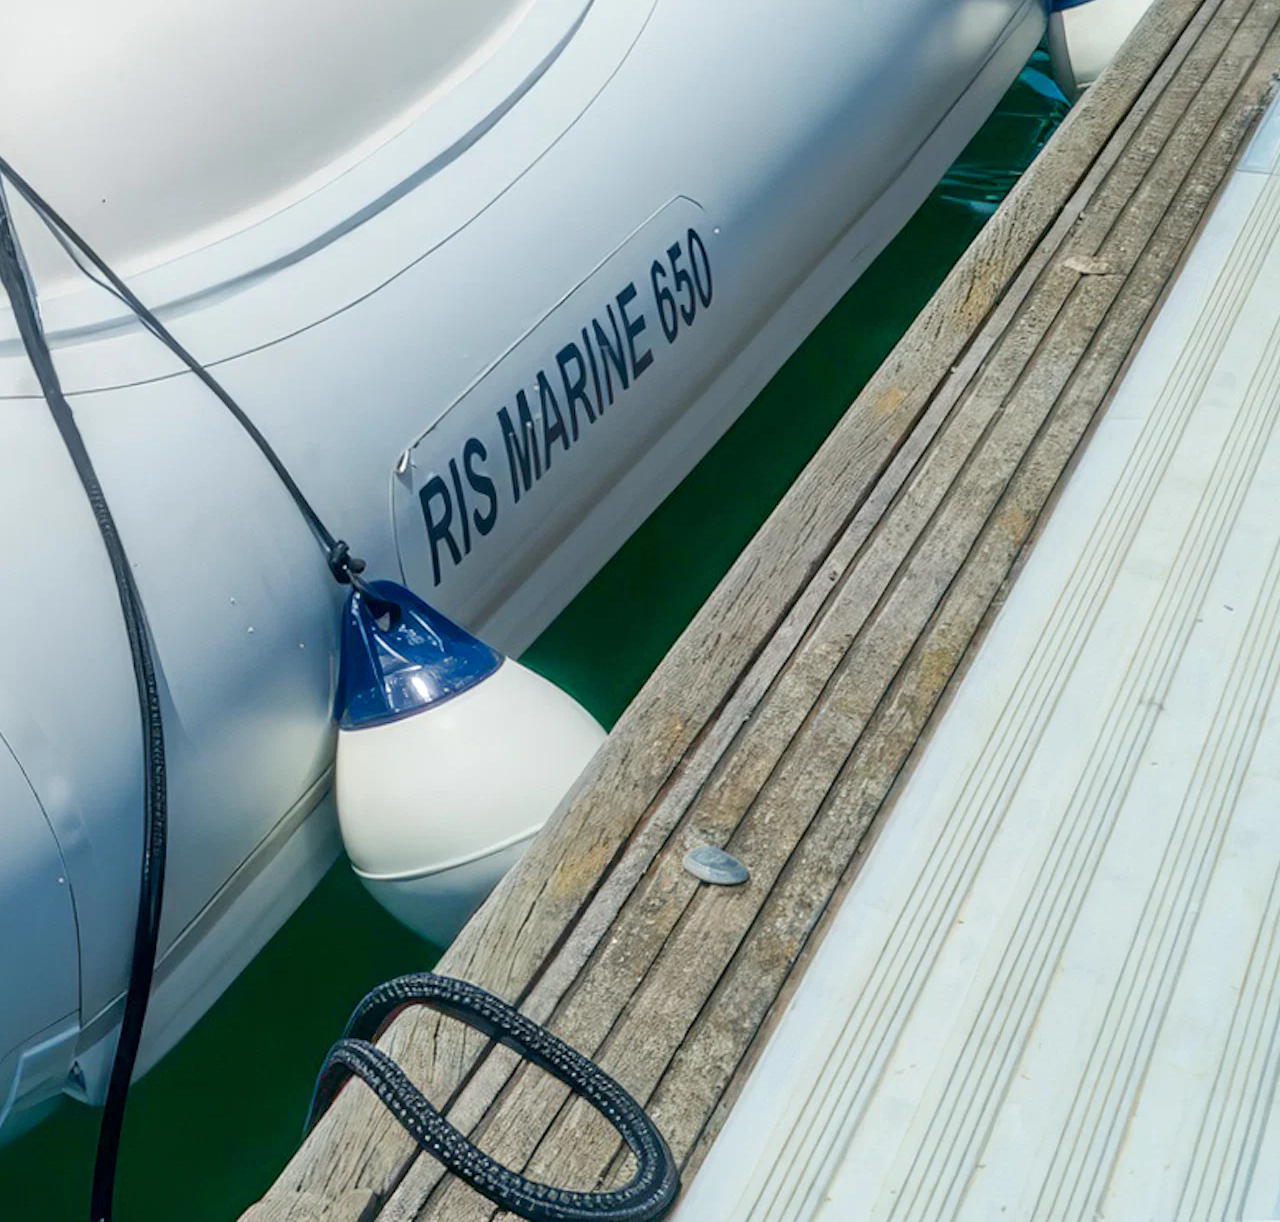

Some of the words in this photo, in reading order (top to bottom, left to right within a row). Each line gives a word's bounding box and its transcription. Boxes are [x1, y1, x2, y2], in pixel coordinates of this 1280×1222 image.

[419, 437, 498, 587] RIS
[496, 282, 654, 504] MARINE
[651, 228, 713, 344] 650
